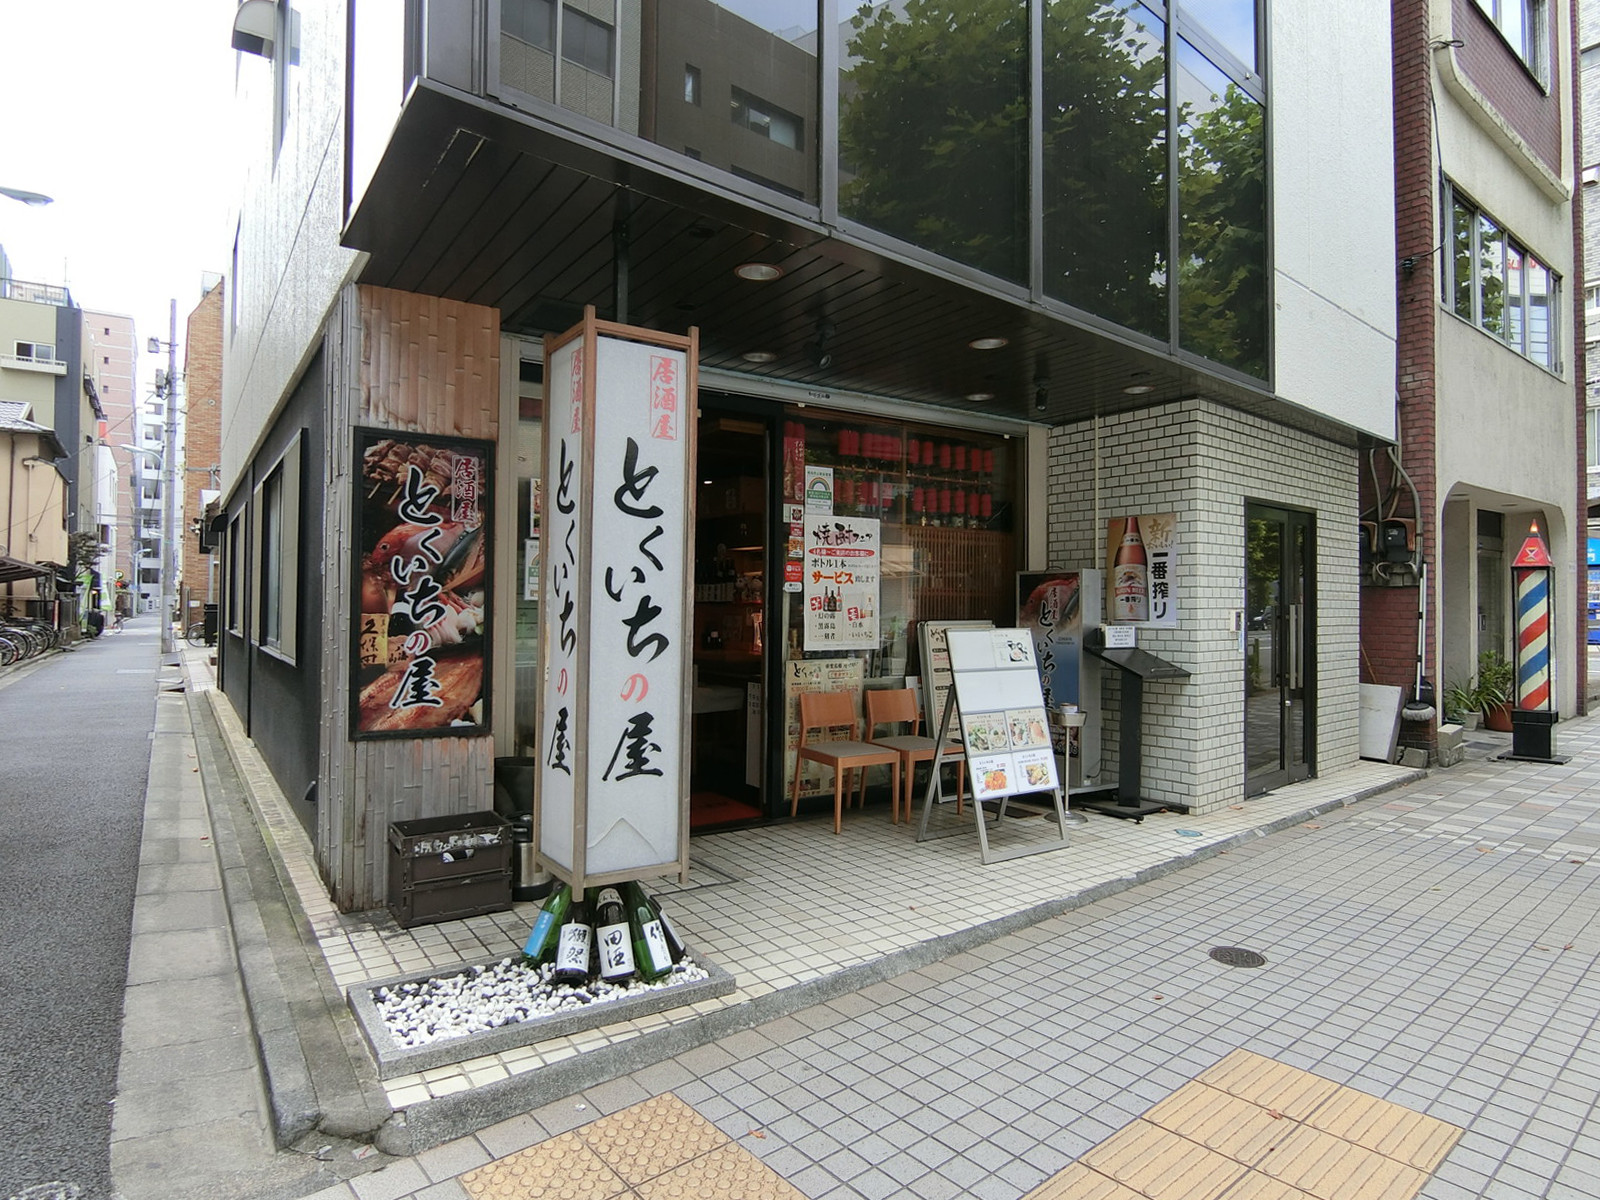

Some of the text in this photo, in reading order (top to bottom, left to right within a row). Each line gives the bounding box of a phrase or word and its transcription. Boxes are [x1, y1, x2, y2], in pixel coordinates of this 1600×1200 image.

[652, 357, 676, 440] 居酒屋
[454, 457, 478, 523] 居酒屋
[1147, 518, 1172, 544] 新
[390, 465, 447, 709] とくいちの屋
[547, 437, 577, 776] とくいちの屋
[602, 436, 670, 782] とくいちの屋
[812, 570, 854, 585] サービス
[1150, 552, 1169, 620] 一番搾り
